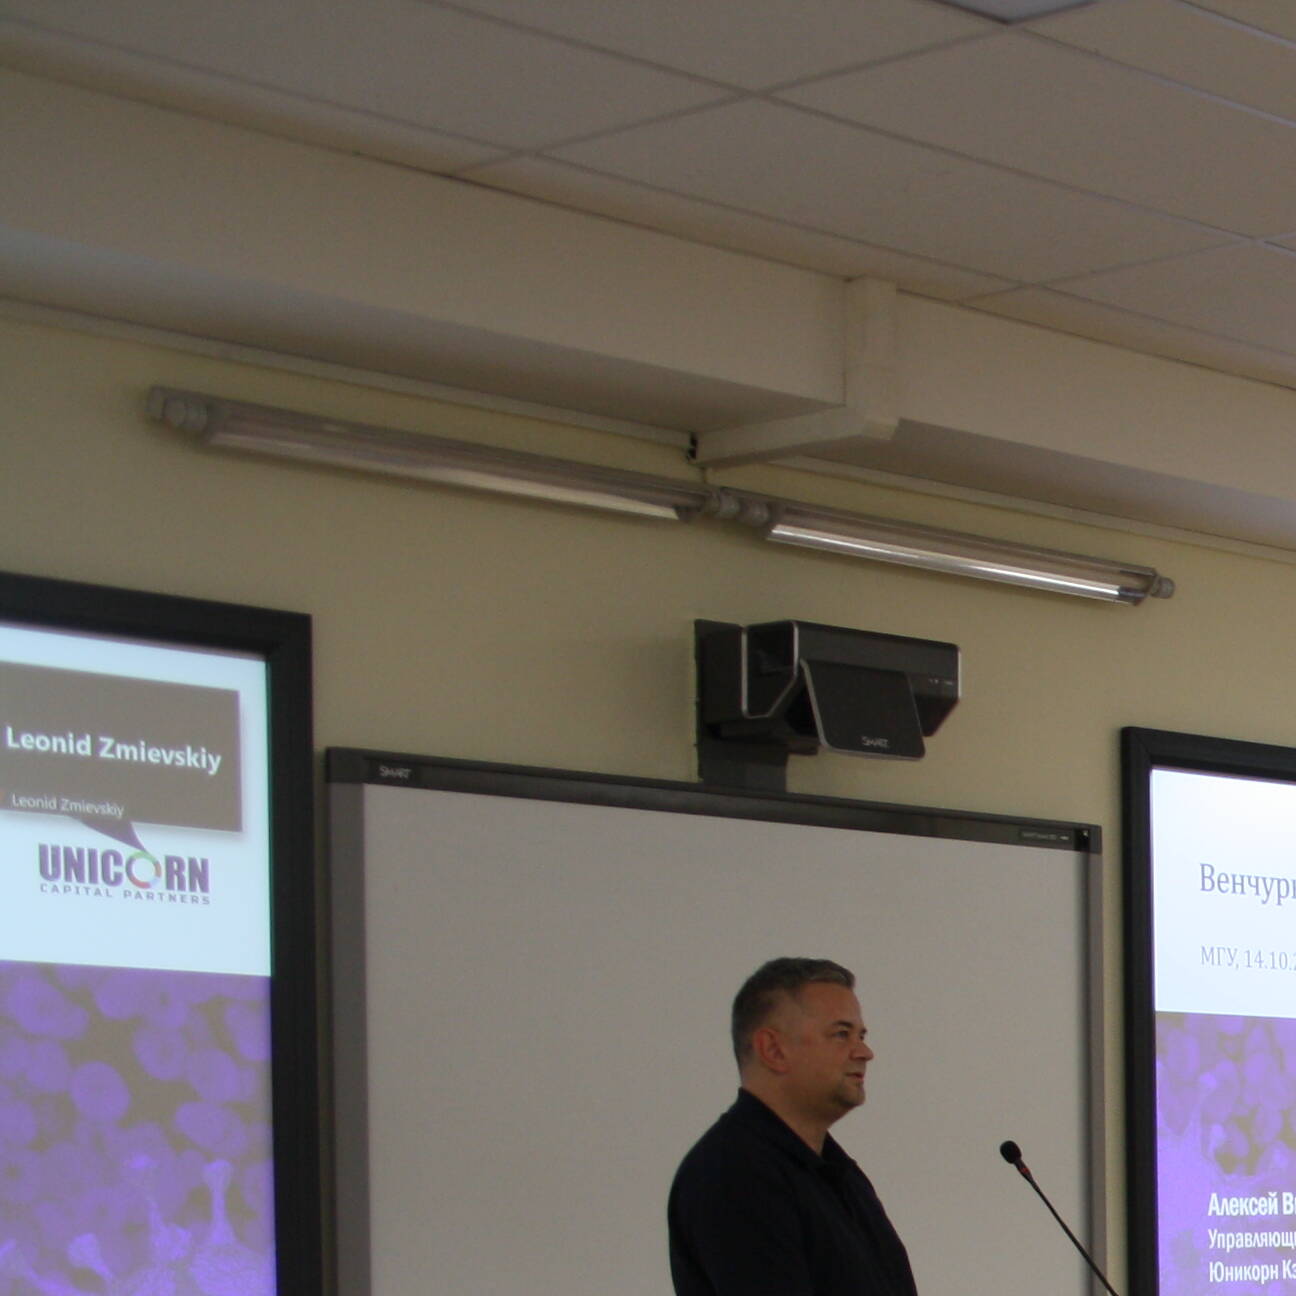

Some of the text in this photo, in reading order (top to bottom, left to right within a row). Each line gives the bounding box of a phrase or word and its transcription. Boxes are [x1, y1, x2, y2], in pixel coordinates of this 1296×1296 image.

[6, 726, 222, 775] Leonid Zmievskiy
[12, 793, 124, 819] Leonid Zmievskiy
[38, 843, 209, 893] UNICORN
[40, 883, 210, 905] CAPITAL PARTNERS
[1201, 945, 1240, 970] МГУ,
[1208, 1192, 1278, 1216] Алексей
[1209, 1261, 1279, 1284] Юникорн
